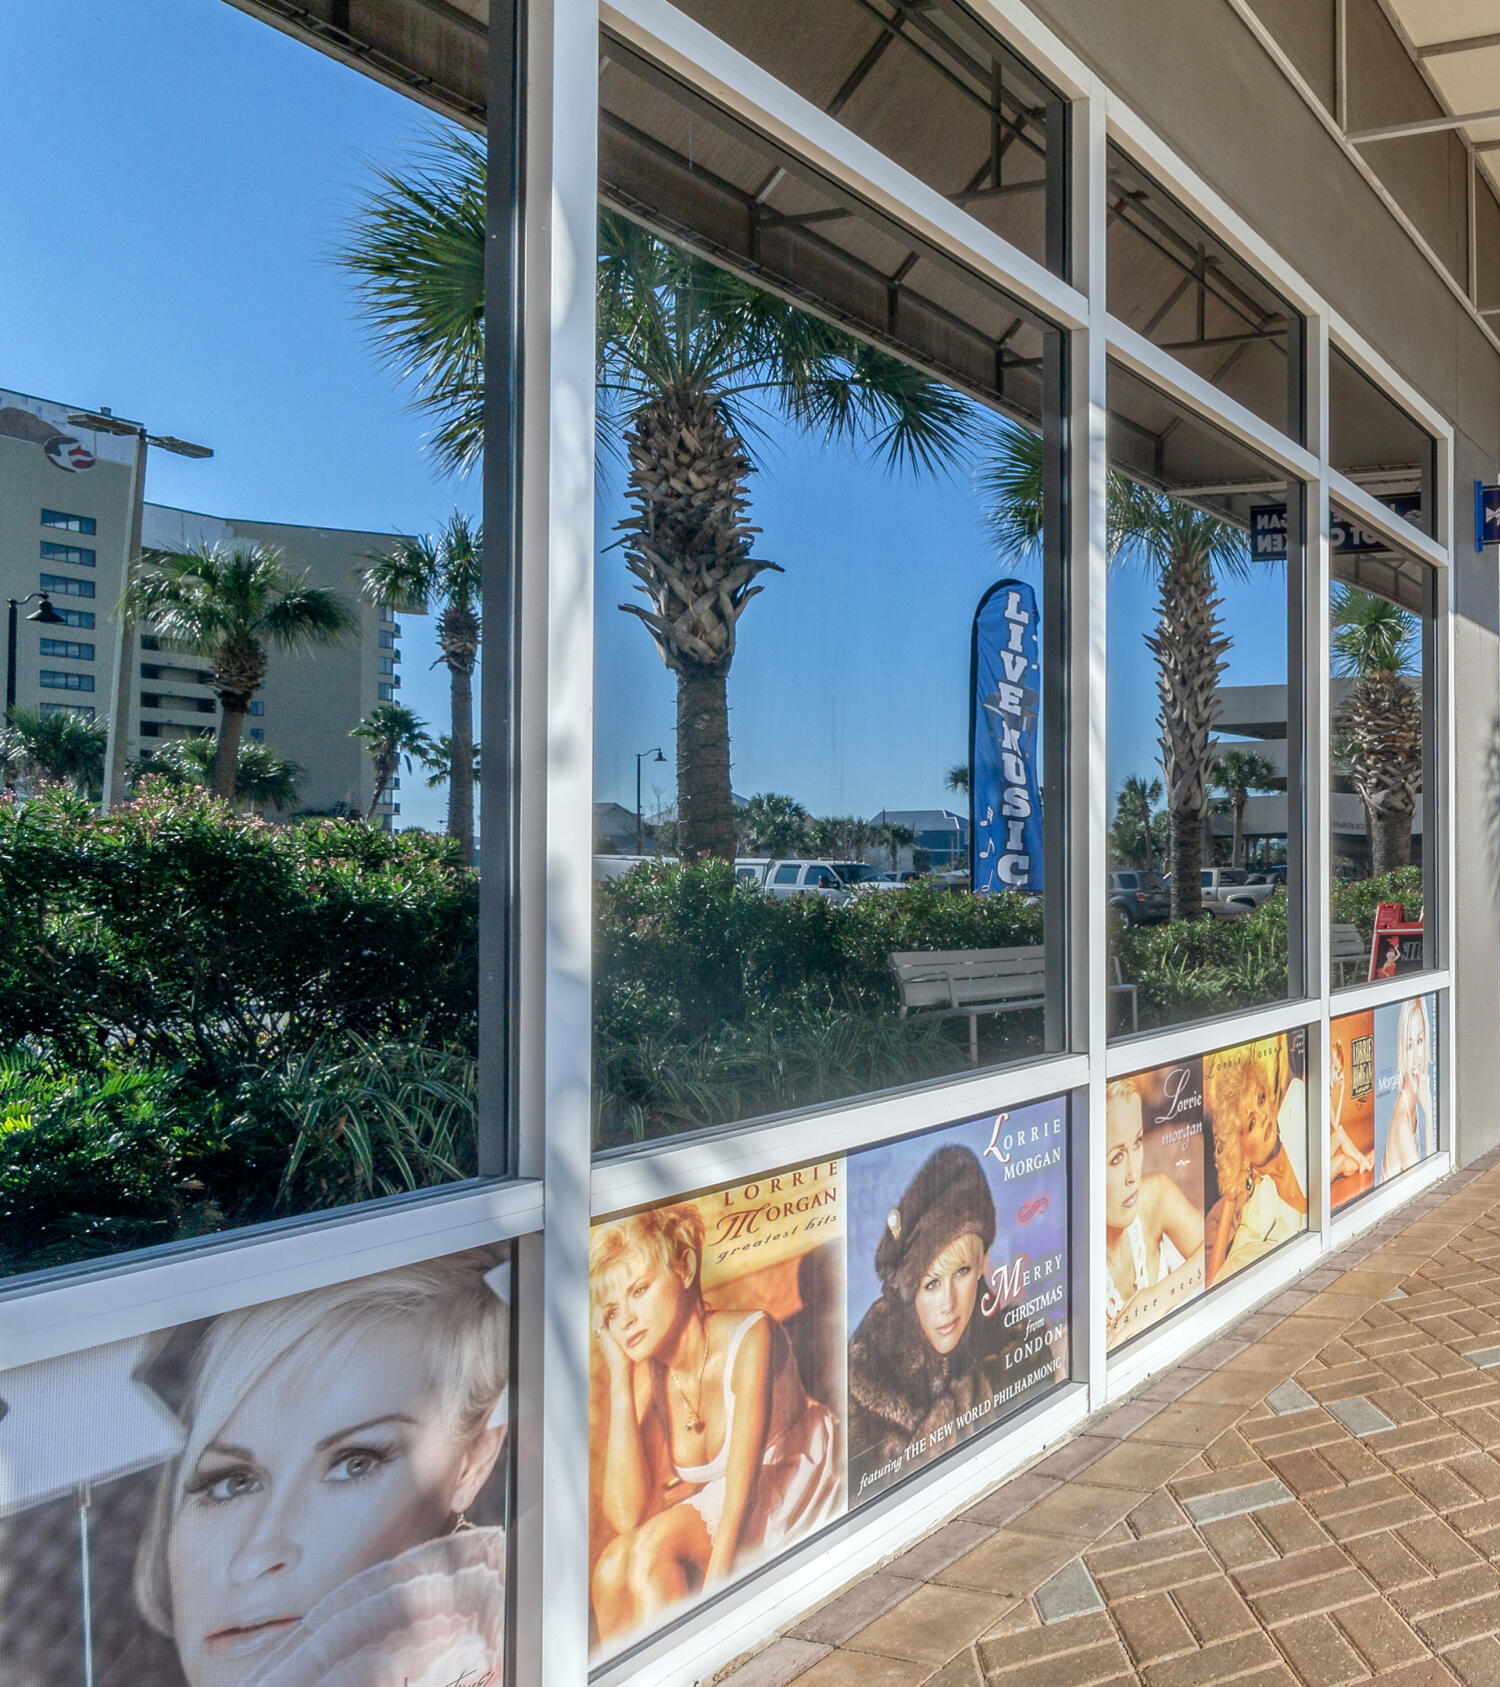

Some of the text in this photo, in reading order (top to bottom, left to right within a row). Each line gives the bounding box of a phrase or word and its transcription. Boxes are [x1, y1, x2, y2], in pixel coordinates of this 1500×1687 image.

[998, 591, 1030, 717] LIVE
[1154, 1068, 1203, 1124] Lorrie
[983, 1113, 1061, 1164] LORRIE
[1162, 1121, 1203, 1152] morgan
[723, 1161, 838, 1207] LORRIE
[1004, 1147, 1061, 1181] MORGAN
[708, 1187, 837, 1247] MORGAN
[716, 1214, 838, 1264] greatest hits
[980, 1254, 1063, 1317] MERRY
[1004, 1285, 1063, 1328] CHRISTMAS
[1004, 1324, 1064, 1370] LONDON
[1023, 1317, 1045, 1341] from
[857, 1356, 1062, 1497] featuring THE NEW WORLD PHILHARMONIC
